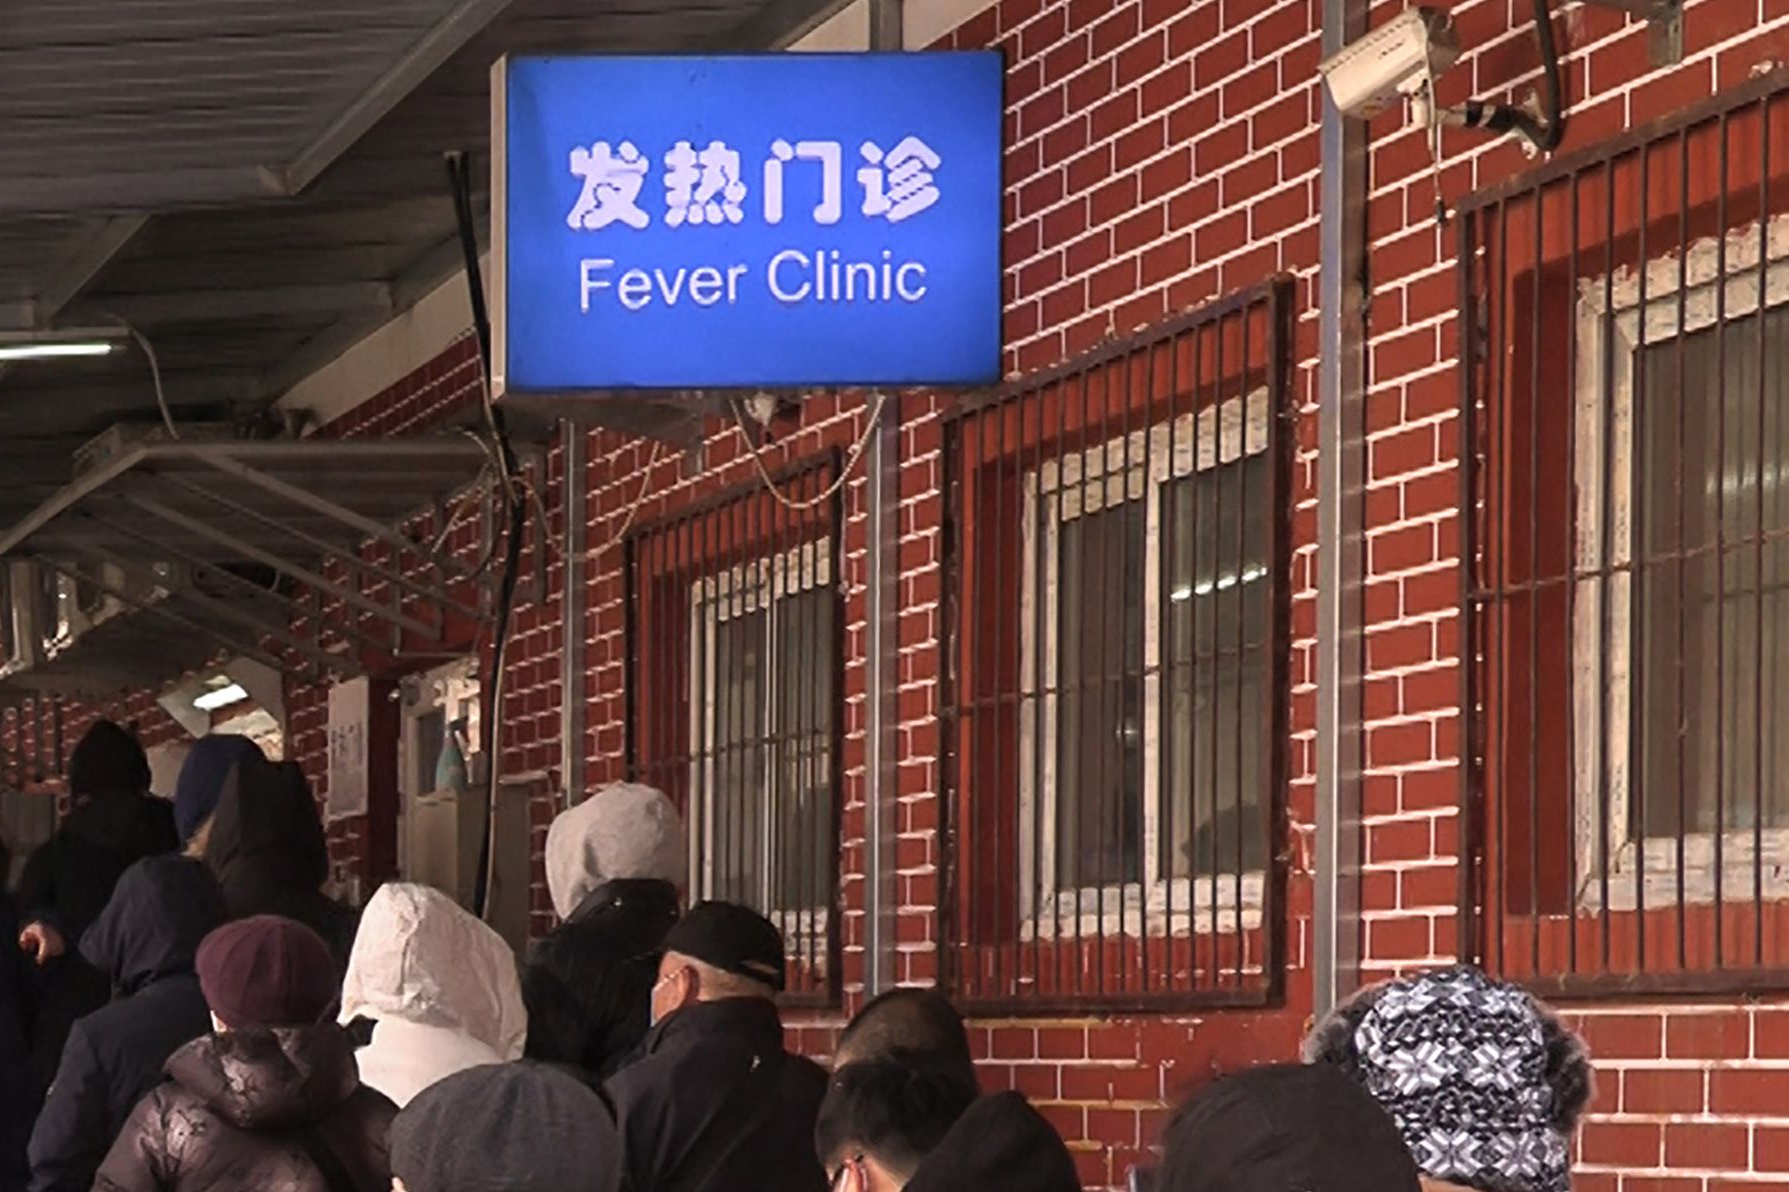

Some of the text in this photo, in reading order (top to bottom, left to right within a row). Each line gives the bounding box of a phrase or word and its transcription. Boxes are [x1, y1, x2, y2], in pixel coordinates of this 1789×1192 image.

[566, 136, 942, 230] 发热门诊
[579, 249, 928, 313] Fever Clinic
